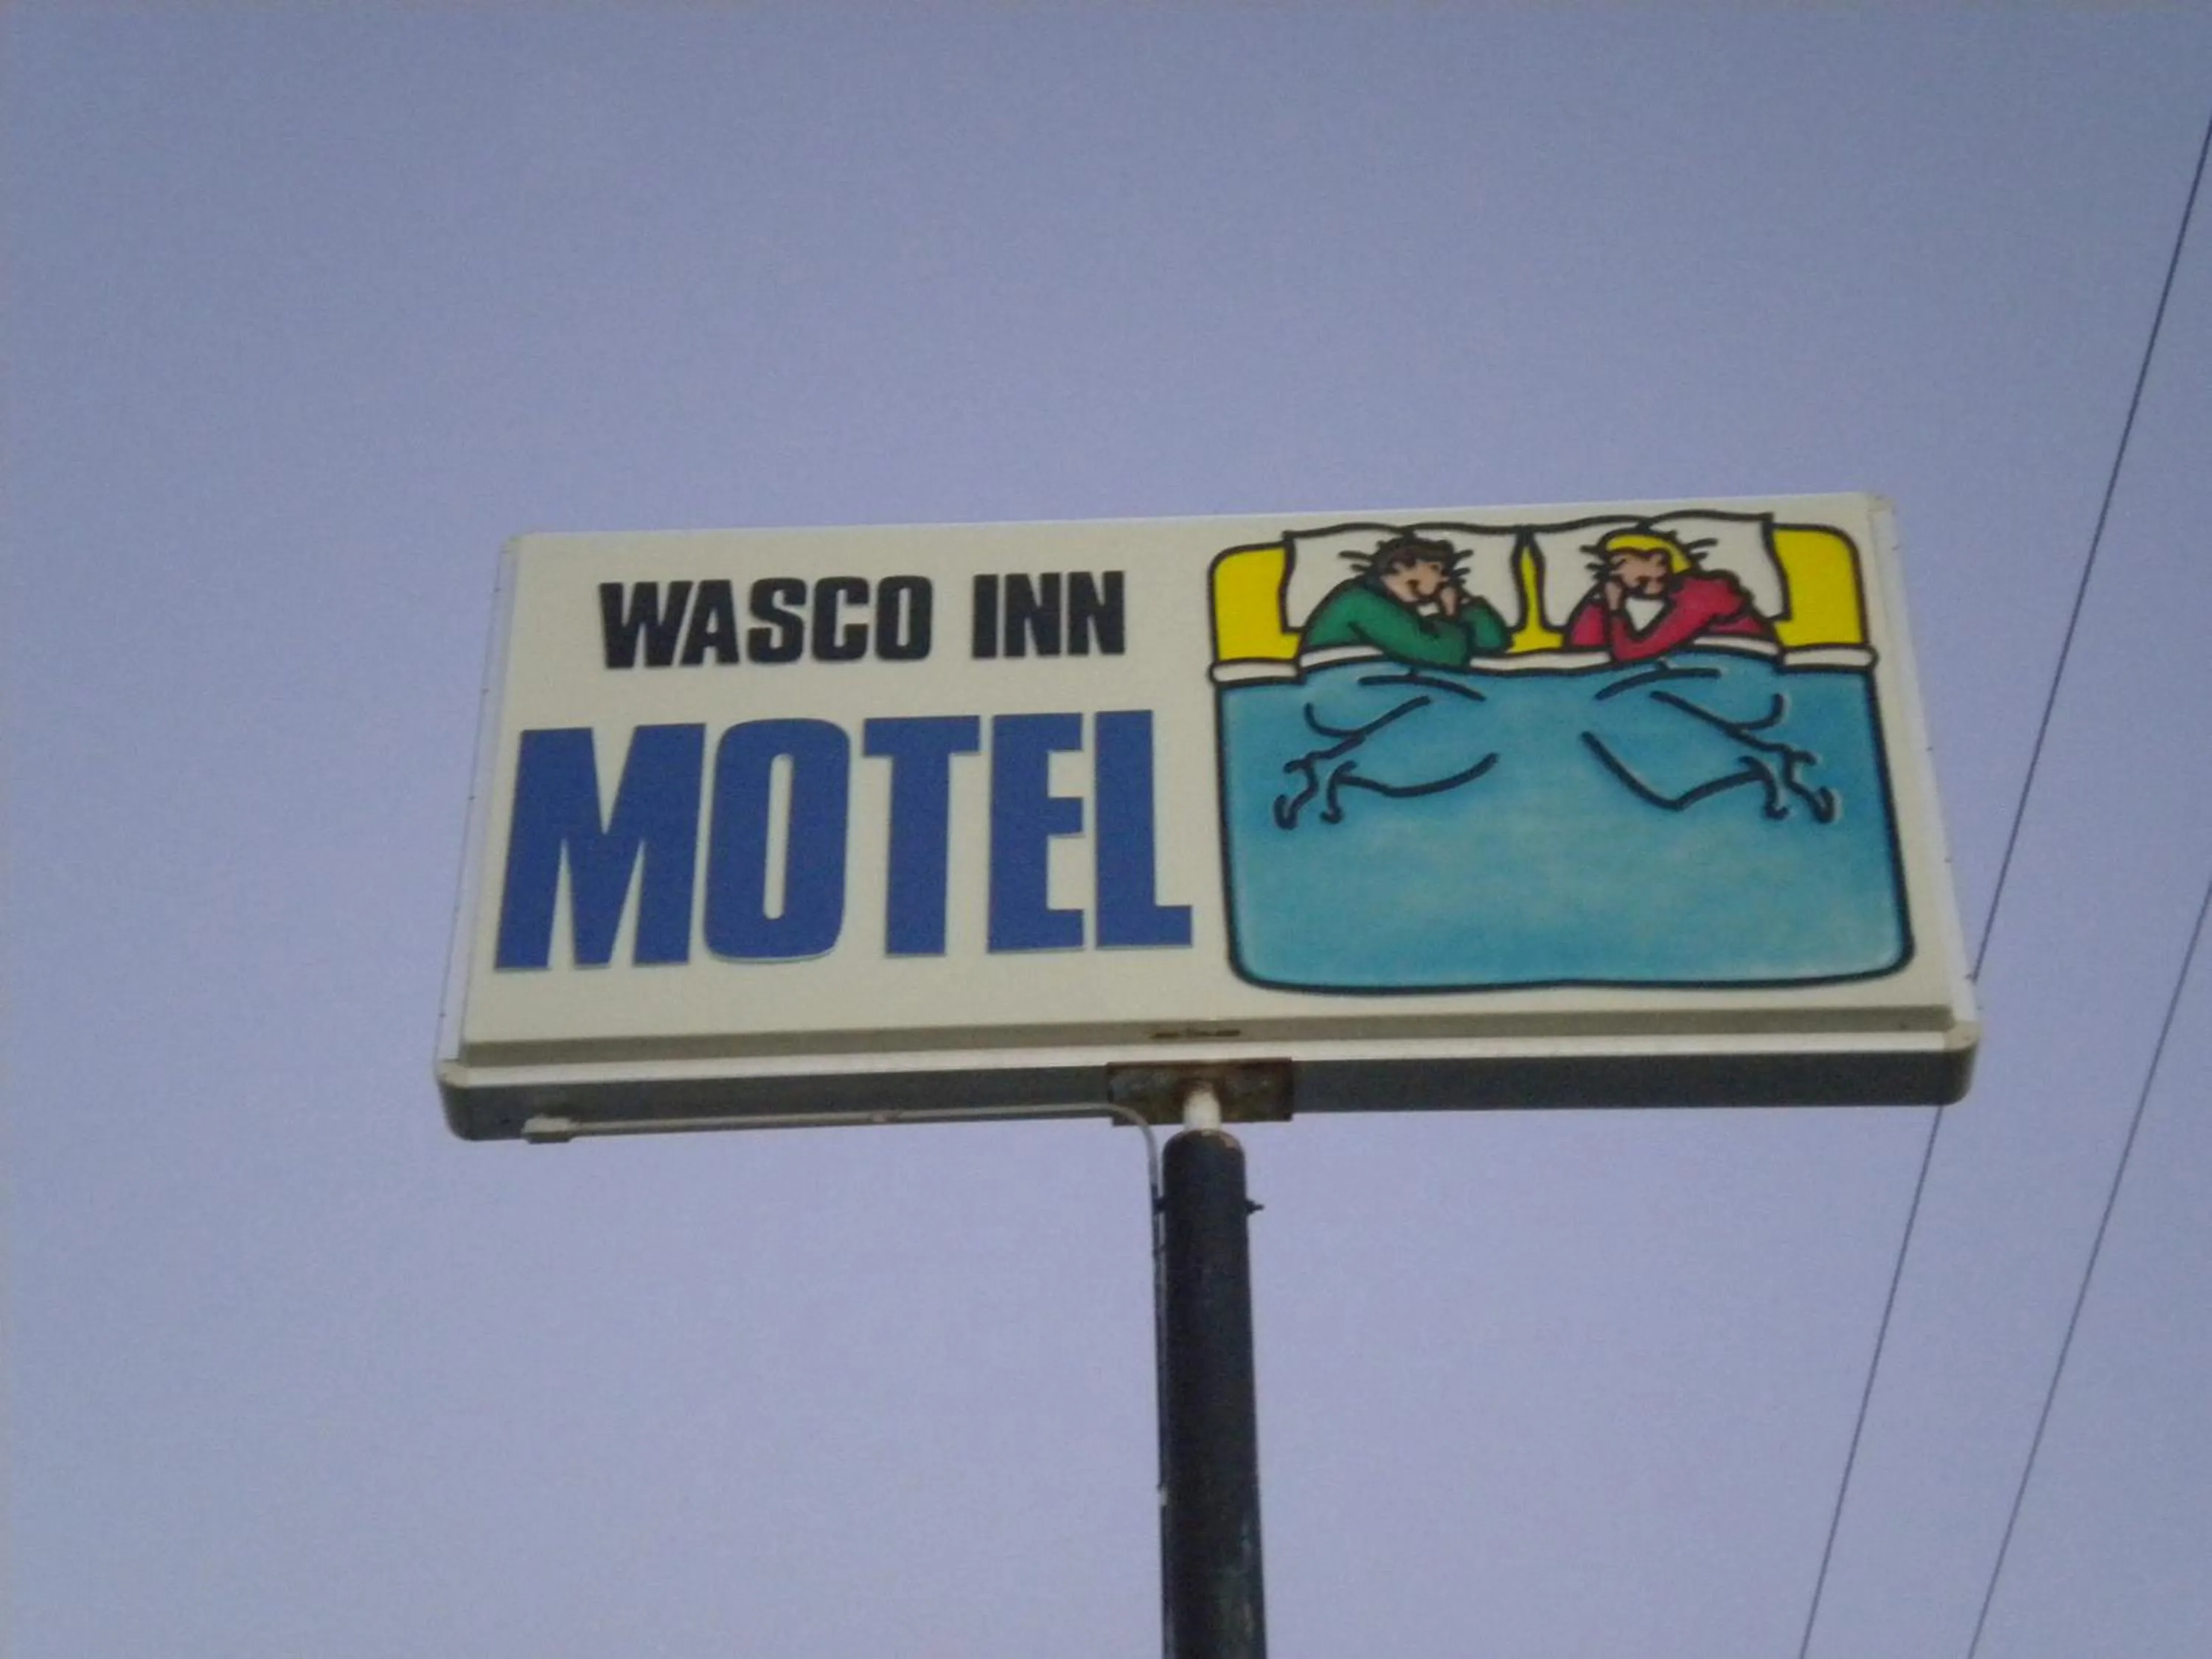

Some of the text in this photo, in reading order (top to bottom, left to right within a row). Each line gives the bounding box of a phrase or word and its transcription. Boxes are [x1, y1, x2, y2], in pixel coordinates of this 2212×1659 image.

[599, 570, 1126, 670] WASCO INN
[495, 709, 1193, 971] MOTEL
